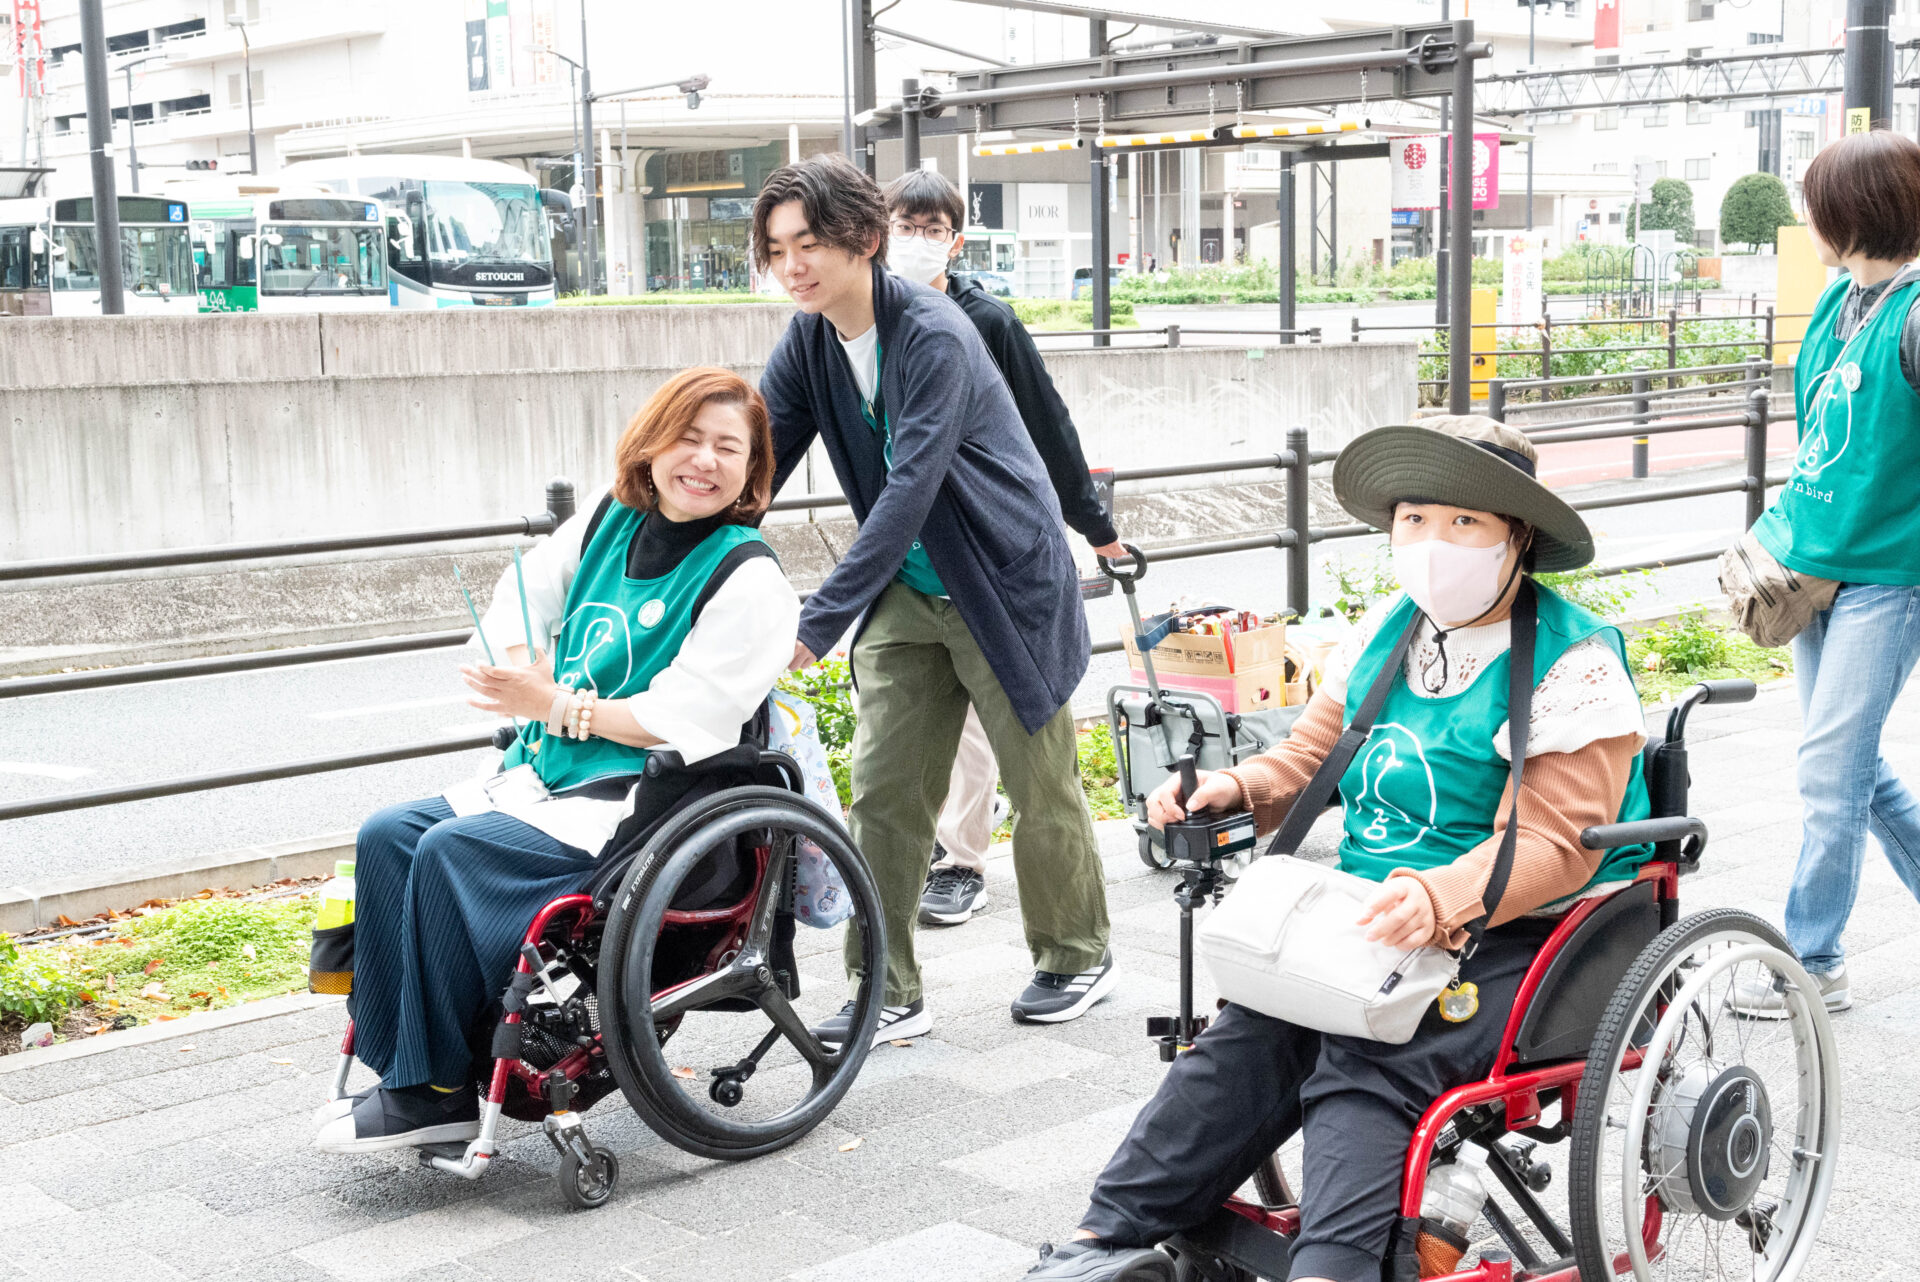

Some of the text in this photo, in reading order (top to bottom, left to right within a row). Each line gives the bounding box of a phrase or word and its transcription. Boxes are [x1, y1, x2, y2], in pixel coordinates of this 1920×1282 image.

[1473, 177, 1487, 187] SE
[1473, 187, 1487, 197] PO
[1028, 204, 1059, 219] DIOR
[475, 272, 525, 281] SETOUCHI
[1806, 483, 1833, 503] bird
[1439, 1133, 1457, 1147] JAPAN
